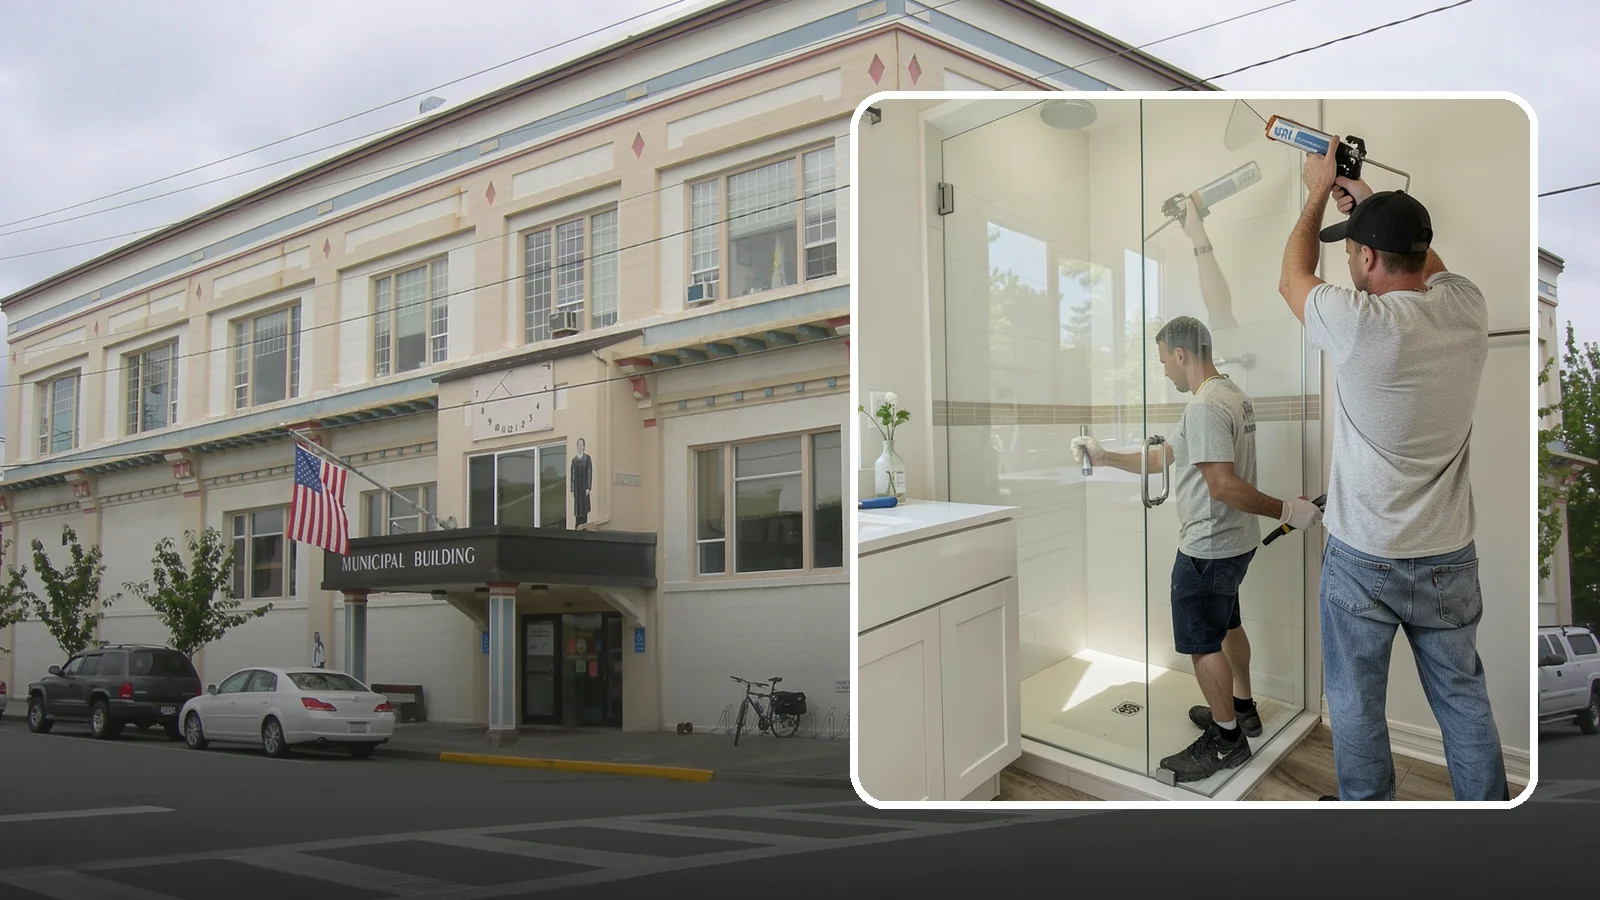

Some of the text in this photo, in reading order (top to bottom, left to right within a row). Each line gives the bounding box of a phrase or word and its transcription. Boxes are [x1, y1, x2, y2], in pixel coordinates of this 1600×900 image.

[481, 407, 485, 415] 8
[488, 418, 492, 426] 9
[494, 423, 500, 432] 10
[501, 425, 506, 434] 11
[507, 425, 513, 434] 12
[342, 546, 475, 572] MUNICIPAL BUILDING
